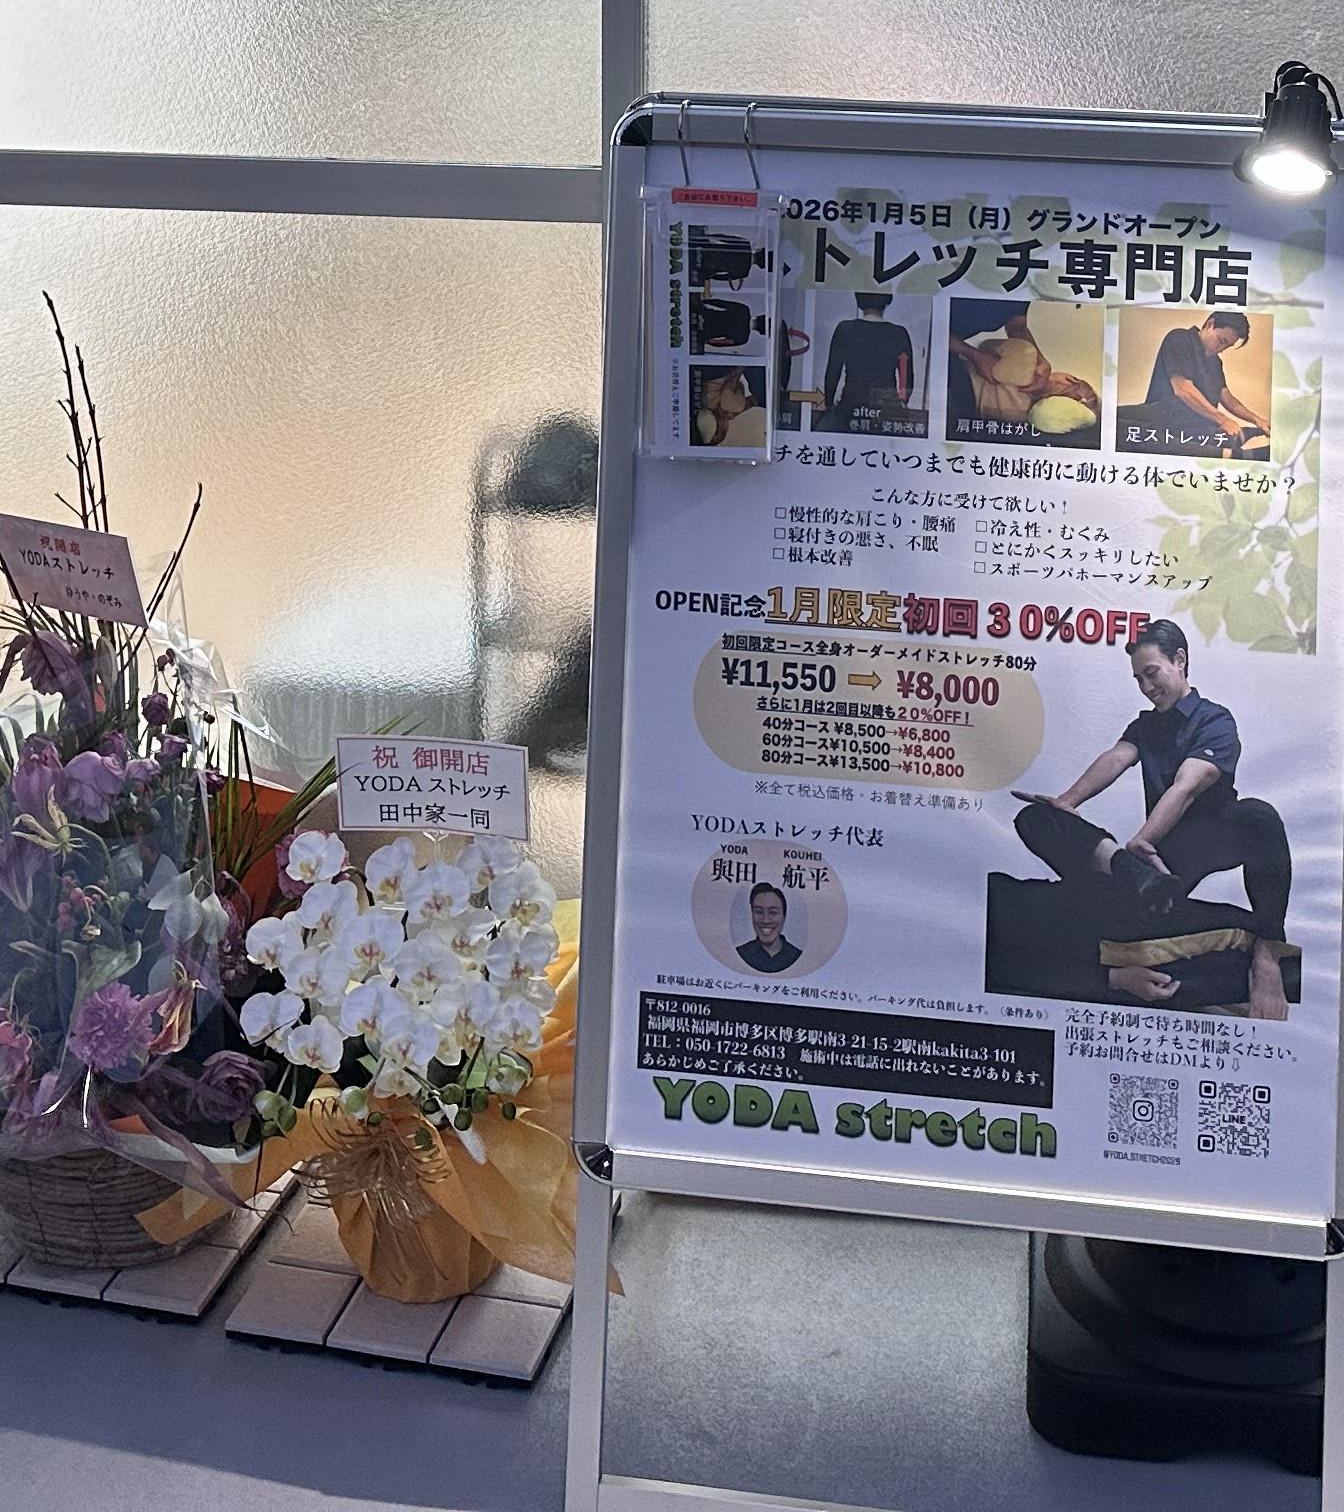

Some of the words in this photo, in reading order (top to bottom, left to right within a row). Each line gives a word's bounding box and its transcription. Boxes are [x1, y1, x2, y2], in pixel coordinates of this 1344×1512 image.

[782, 227, 1253, 307] トレッチ専門店
[853, 406, 882, 418] after
[956, 418, 1041, 437] 肩甲骨はがし
[1126, 426, 1229, 448] 足ストレッチ
[872, 488, 1067, 515] こんな方に受けて欲しい！
[18, 548, 115, 580] YODAストレッチ
[721, 657, 836, 695] ¥11,550
[897, 669, 1000, 708] ¥8,000
[379, 802, 490, 830] 田中家一同
[690, 814, 884, 847] YODAストレッチ代表
[720, 844, 748, 855] YODA
[783, 849, 823, 861] KOUHEI
[653, 1076, 820, 1134] YODA
[835, 1098, 1057, 1159] stretch
[1222, 1114, 1246, 1125] LINE
